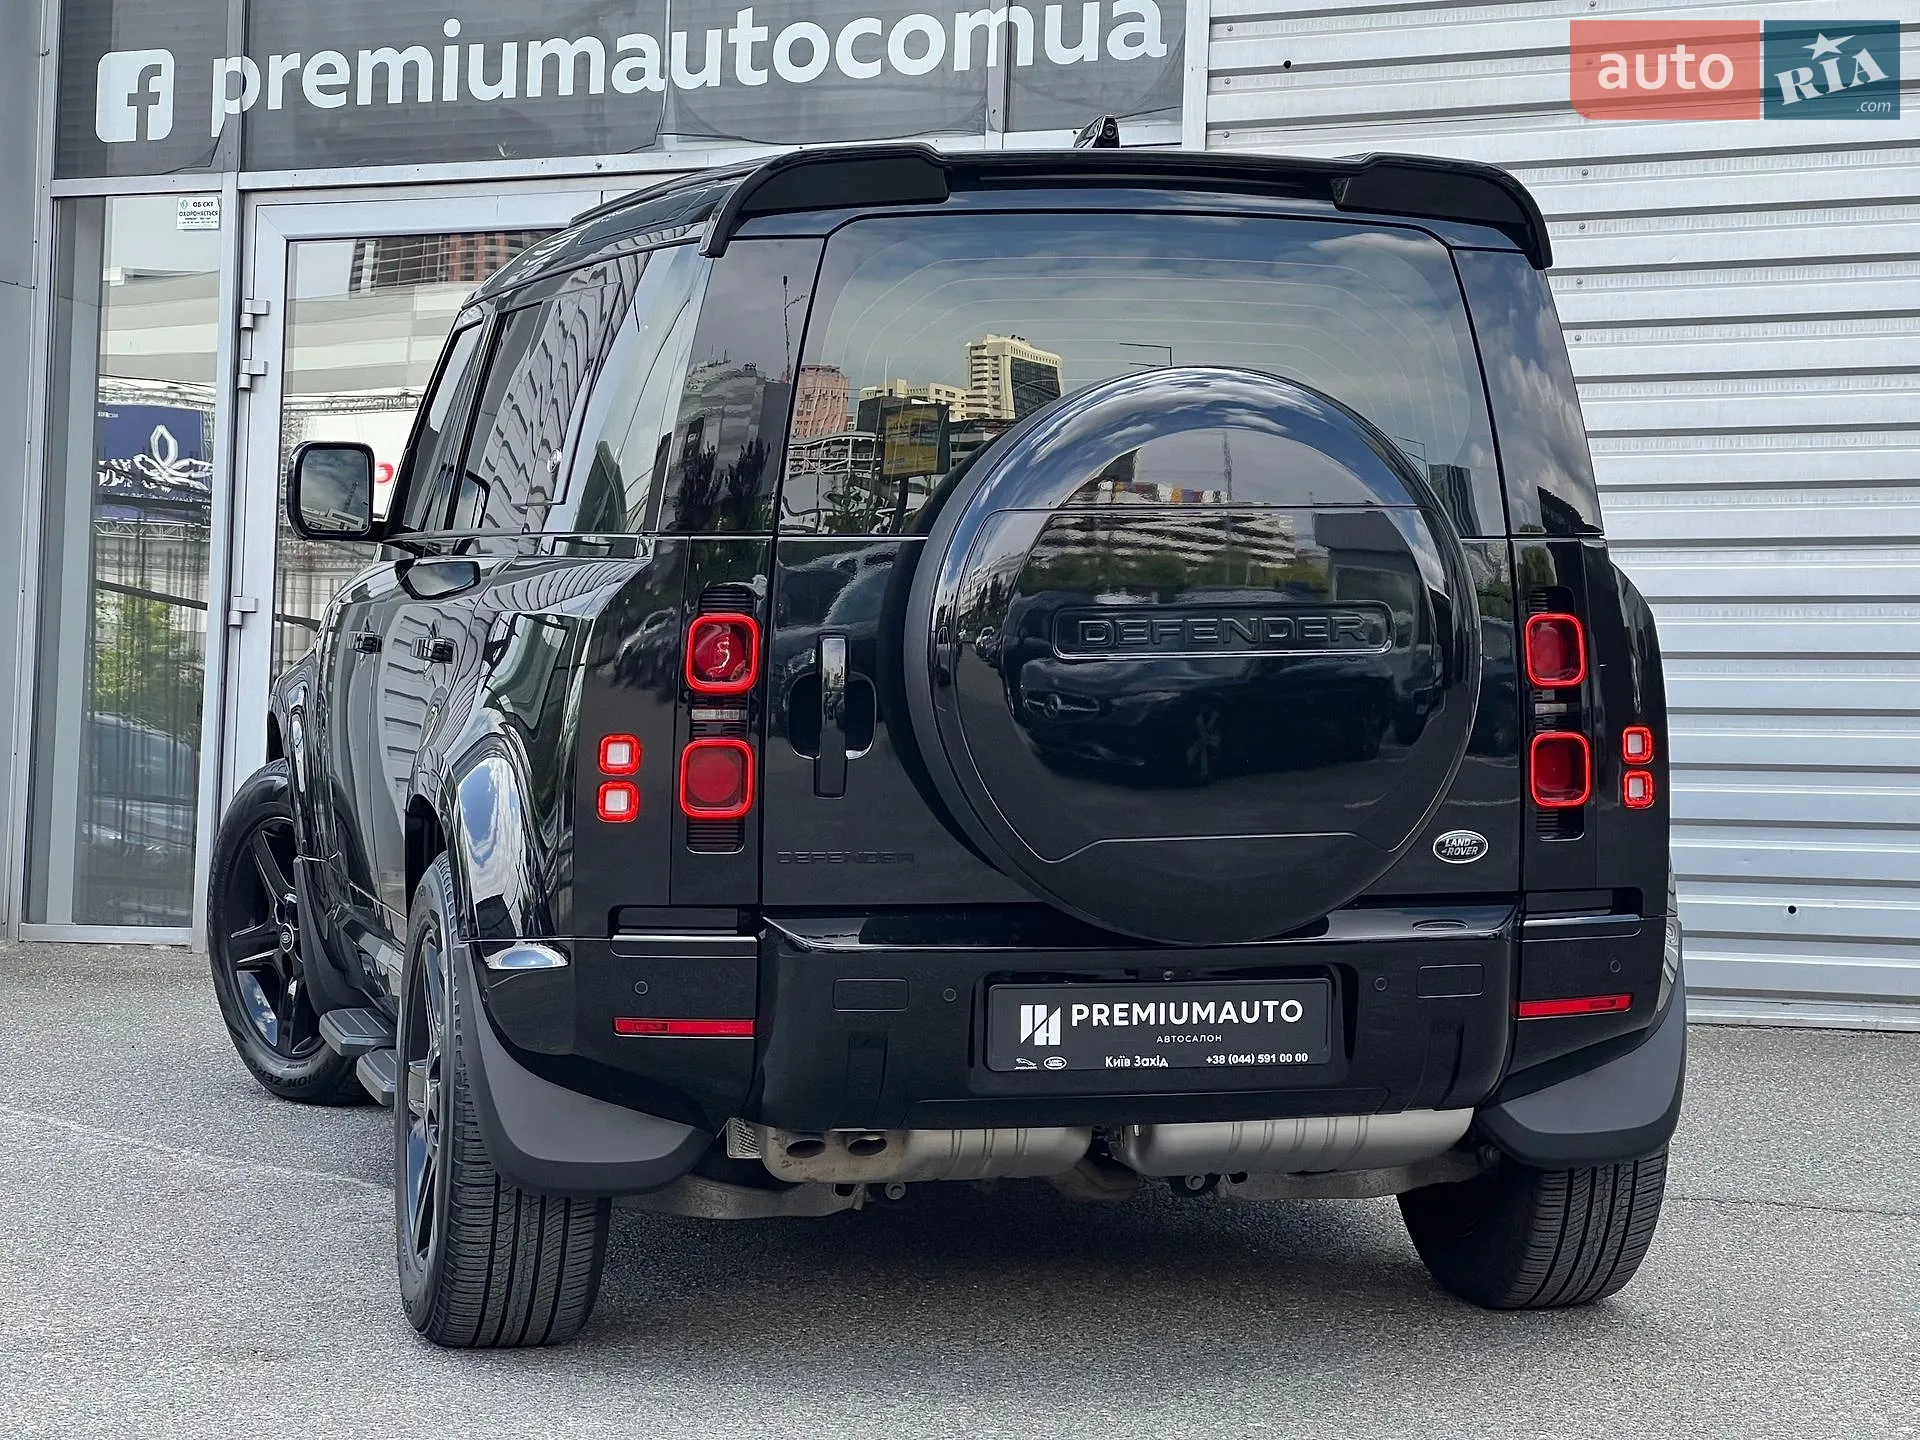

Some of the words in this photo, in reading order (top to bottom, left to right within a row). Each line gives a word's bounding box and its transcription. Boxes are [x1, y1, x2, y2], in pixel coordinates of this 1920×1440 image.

[210, 0, 1167, 138] premiumautocomua
[1077, 615, 1367, 647] DEFENDER
[1445, 838, 1470, 846] LAND
[776, 850, 916, 864] DEFENDER
[1447, 847, 1478, 855] ROVER
[1071, 999, 1304, 1027] PREMIUMAUTO
[1156, 1034, 1223, 1044] АВТОСАЛОН
[1105, 1055, 1131, 1068] Київ
[1133, 1054, 1169, 1068] Захід
[1205, 1054, 1226, 1065] +38
[1228, 1053, 1256, 1065] (044)
[1257, 1053, 1276, 1064] 591
[1279, 1053, 1293, 1064] 00
[1294, 1052, 1309, 1064] 00
